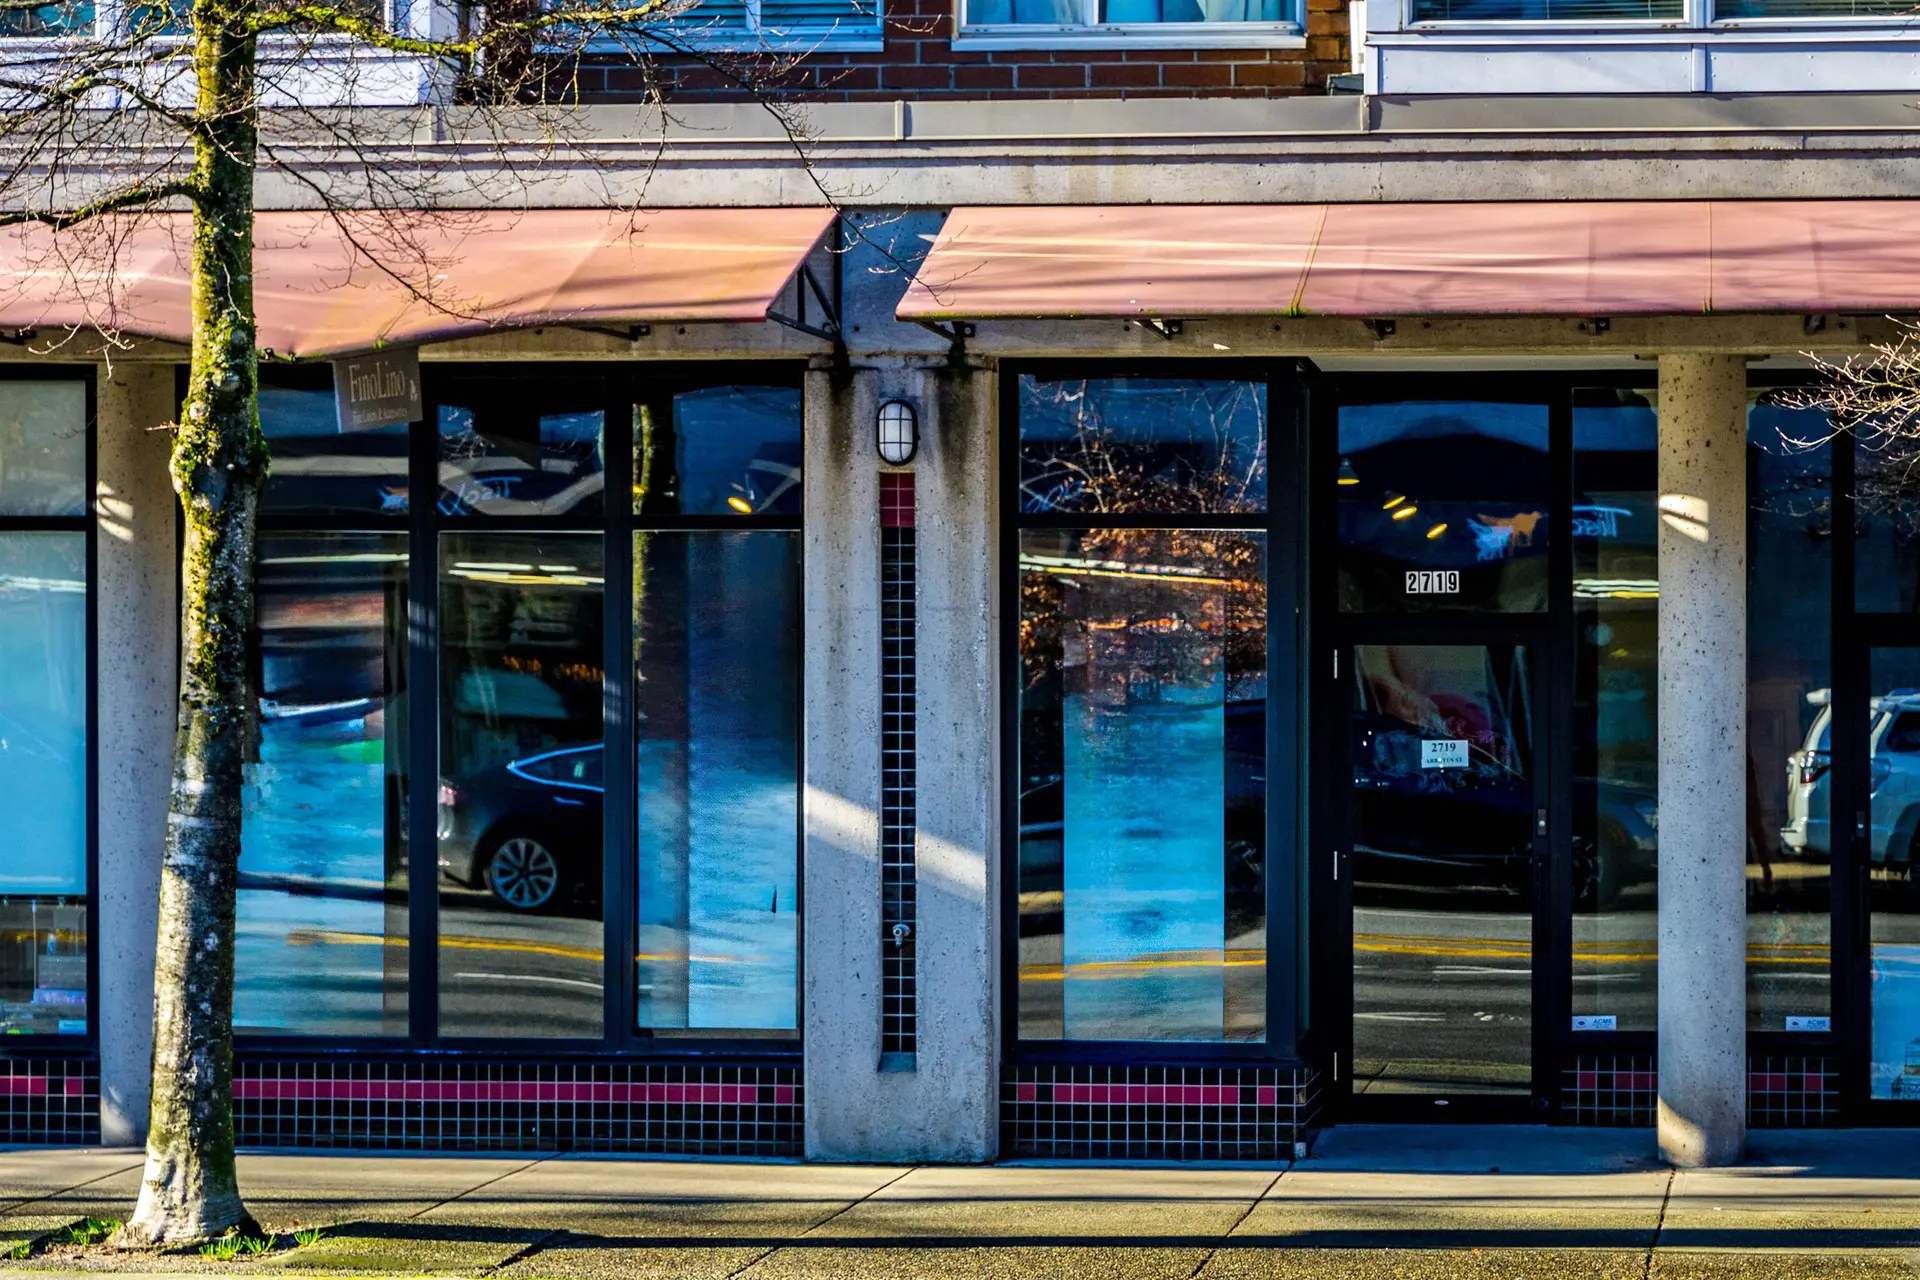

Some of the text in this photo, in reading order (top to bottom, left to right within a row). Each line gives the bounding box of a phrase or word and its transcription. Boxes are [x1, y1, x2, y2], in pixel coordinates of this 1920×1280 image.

[348, 361, 405, 403] FinoLino
[1407, 572, 1458, 592] 2719
[1431, 742, 1456, 752] 2719
